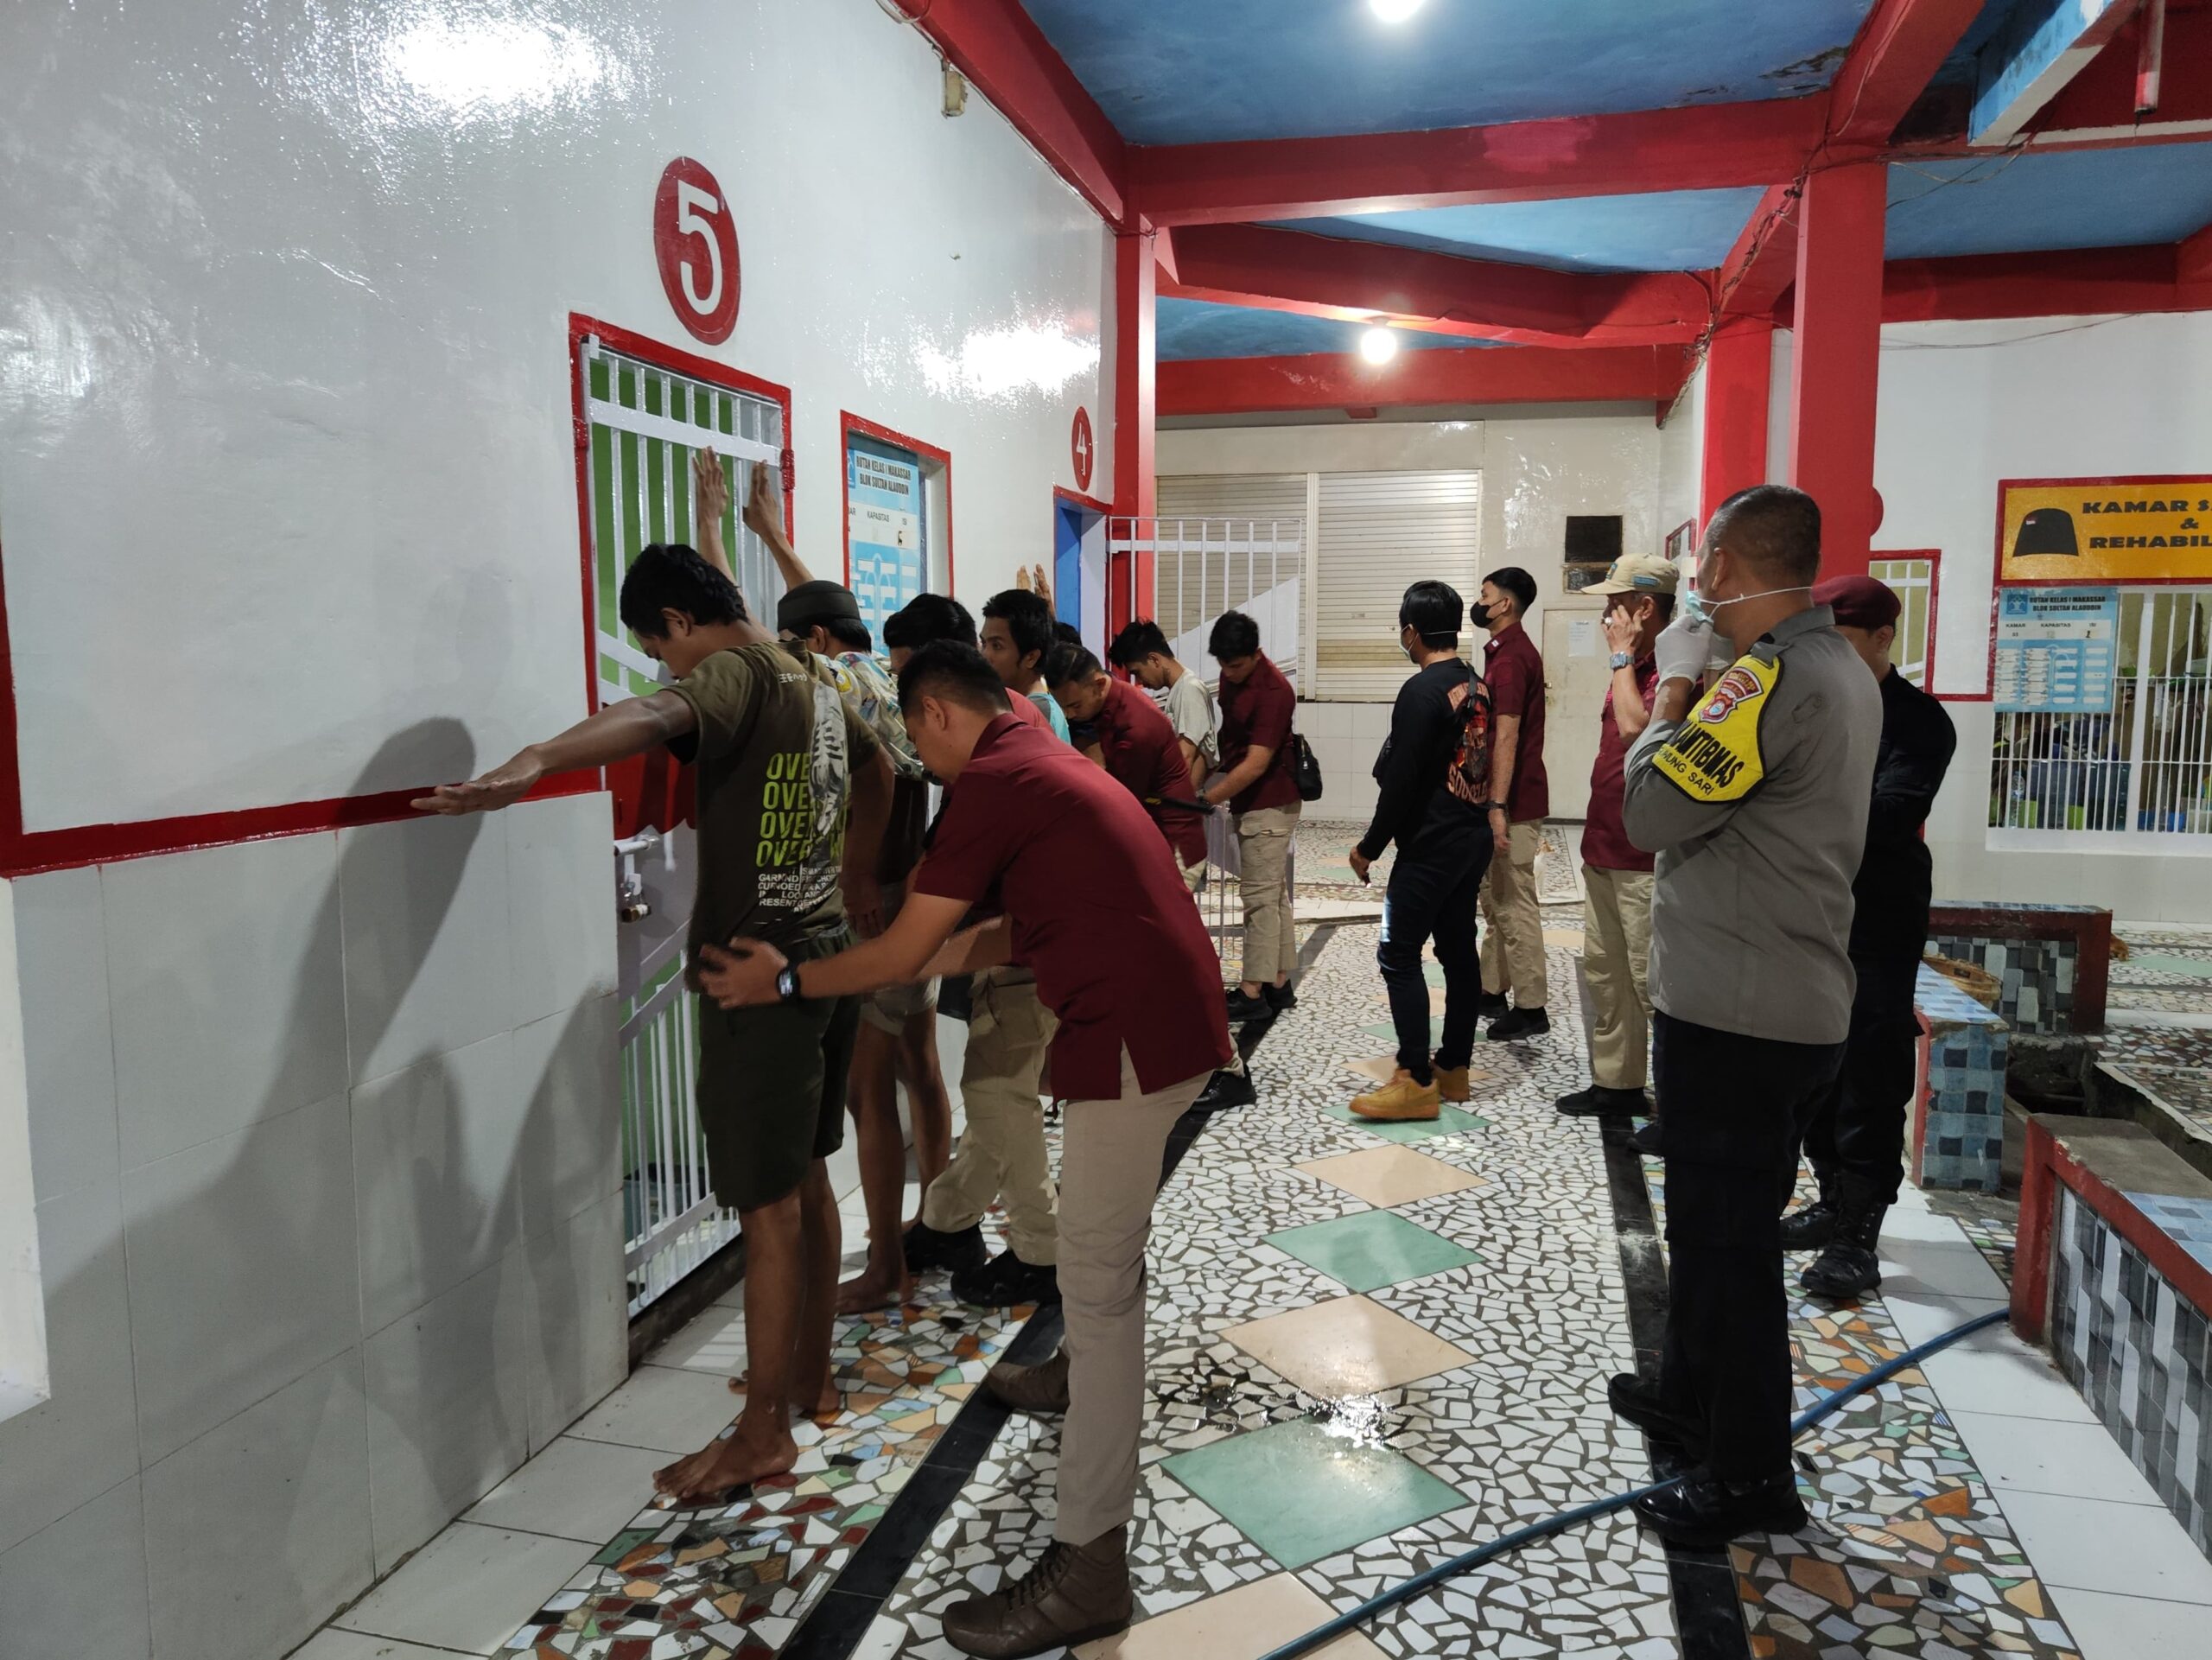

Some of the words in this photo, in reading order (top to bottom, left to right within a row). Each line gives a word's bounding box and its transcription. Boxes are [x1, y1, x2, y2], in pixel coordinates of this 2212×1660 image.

[677, 179, 723, 315] 5
[1076, 422, 1088, 476] 4
[871, 460, 885, 474] KELAS
[888, 464, 911, 480] MAKASSAR
[860, 473, 871, 487] BLOK
[872, 476, 887, 491] SULTAN
[888, 480, 909, 496] ALAUDDIN
[2082, 500, 2189, 513] KAMAR
[2197, 499, 2212, 512] S
[867, 511, 890, 522] KAPASITAS
[2180, 518, 2199, 530] &
[2089, 536, 2212, 548] REHABIL
[1688, 772, 1714, 795] SARI
